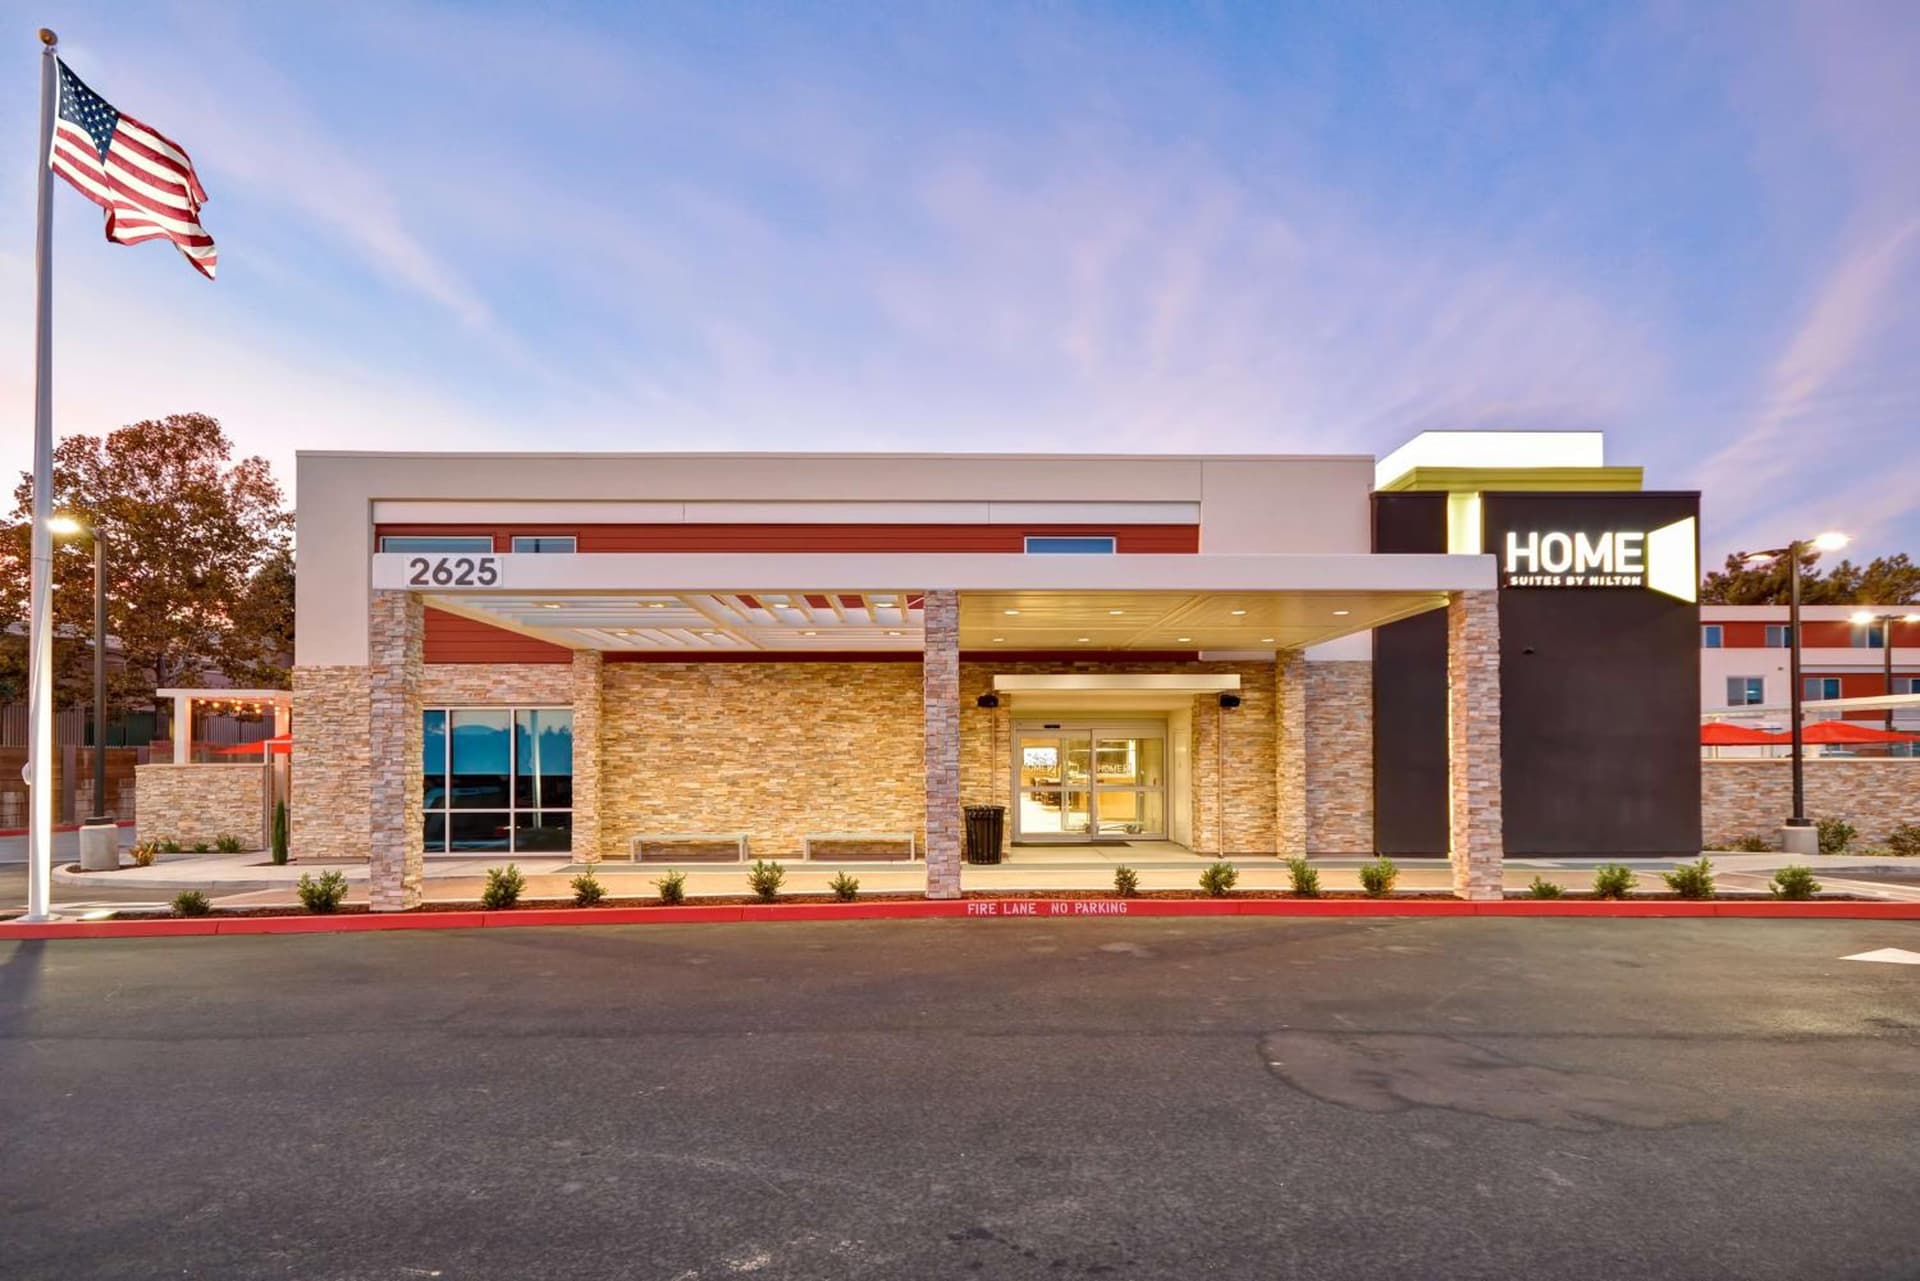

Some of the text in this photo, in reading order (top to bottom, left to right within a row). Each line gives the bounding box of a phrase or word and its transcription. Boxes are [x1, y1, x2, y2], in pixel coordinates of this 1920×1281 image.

[1507, 532, 1645, 573] HOME
[410, 558, 498, 586] 2625
[1510, 576, 1641, 586] SUITES BY HILTON
[967, 902, 1128, 915] FIRE LANE NO PARKING
